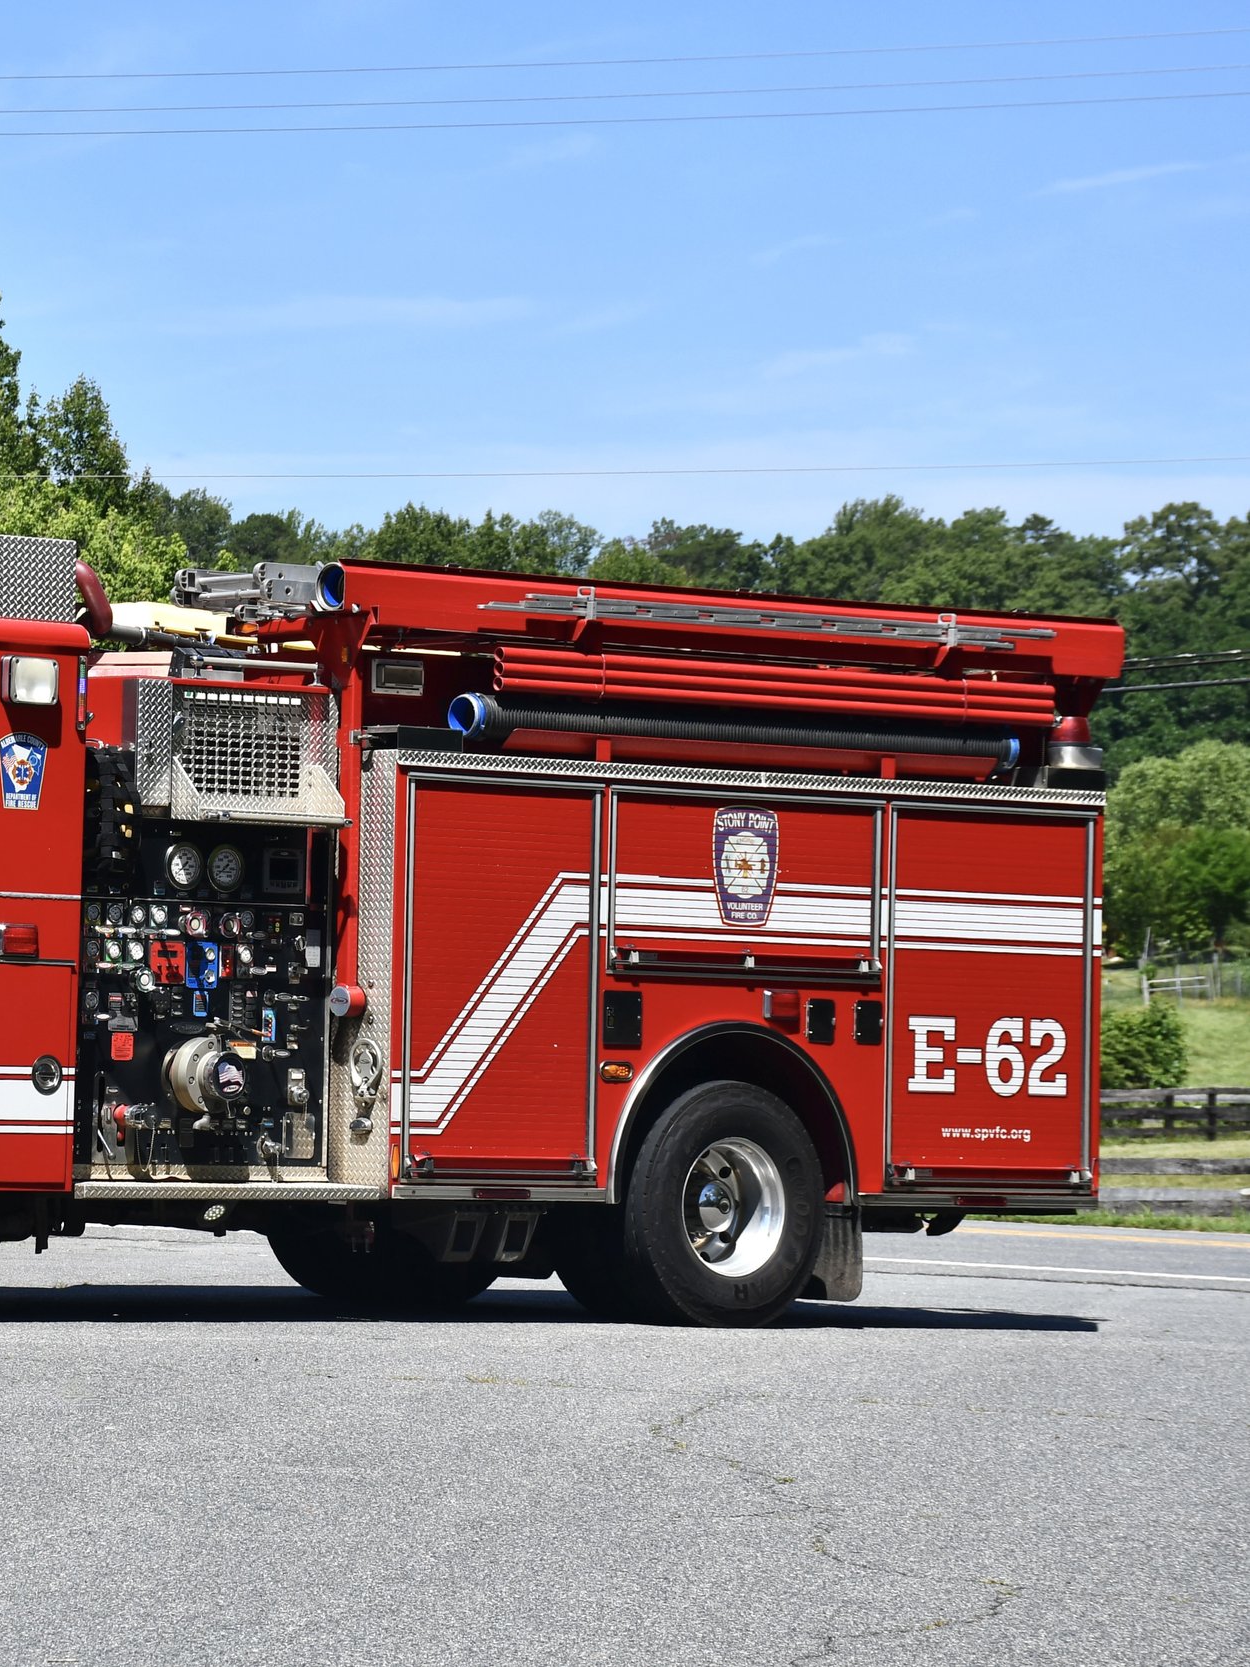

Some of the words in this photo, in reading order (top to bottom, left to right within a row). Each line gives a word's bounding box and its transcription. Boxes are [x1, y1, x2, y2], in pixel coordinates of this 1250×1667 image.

[26, 735, 46, 751] COUNTY
[5, 792, 31, 801] DEPARTMENT
[32, 793, 37, 801] OF
[5, 800, 17, 808] FIRE
[716, 811, 746, 832] STONY
[748, 812, 776, 834] POINT
[727, 902, 764, 911] VOLUNTEER
[731, 911, 745, 919] FIRE
[746, 912, 758, 920] CO.
[908, 1015, 1068, 1097] E-62
[941, 1126, 1031, 1142] www.spvfc.org
